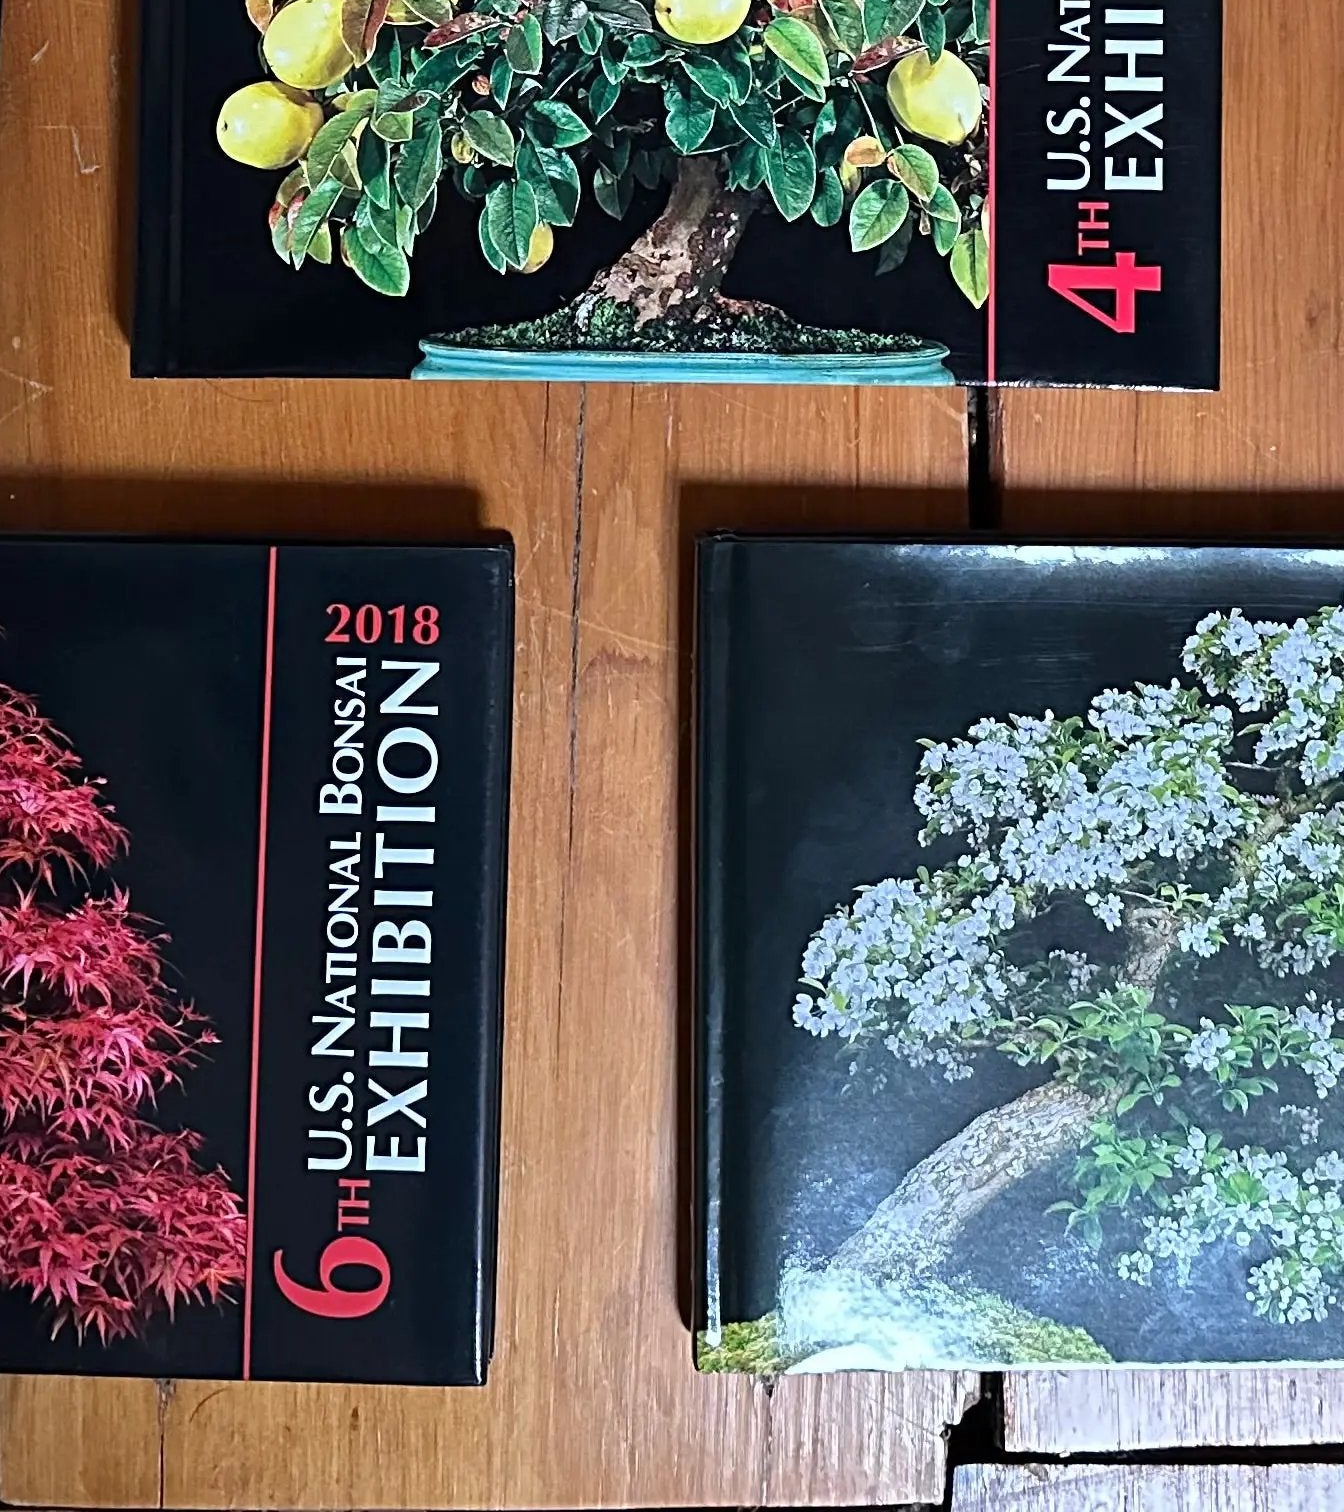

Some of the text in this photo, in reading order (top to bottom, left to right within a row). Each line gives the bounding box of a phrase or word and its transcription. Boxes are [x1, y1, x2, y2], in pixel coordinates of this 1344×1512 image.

[1045, 91, 1091, 191] U.S.
[1047, 201, 1162, 334] 4TH
[325, 604, 440, 645] 2018
[365, 659, 440, 1173] EXHIBITION
[273, 656, 391, 1319] 6TH U.S. NATIONAL BONSAI
